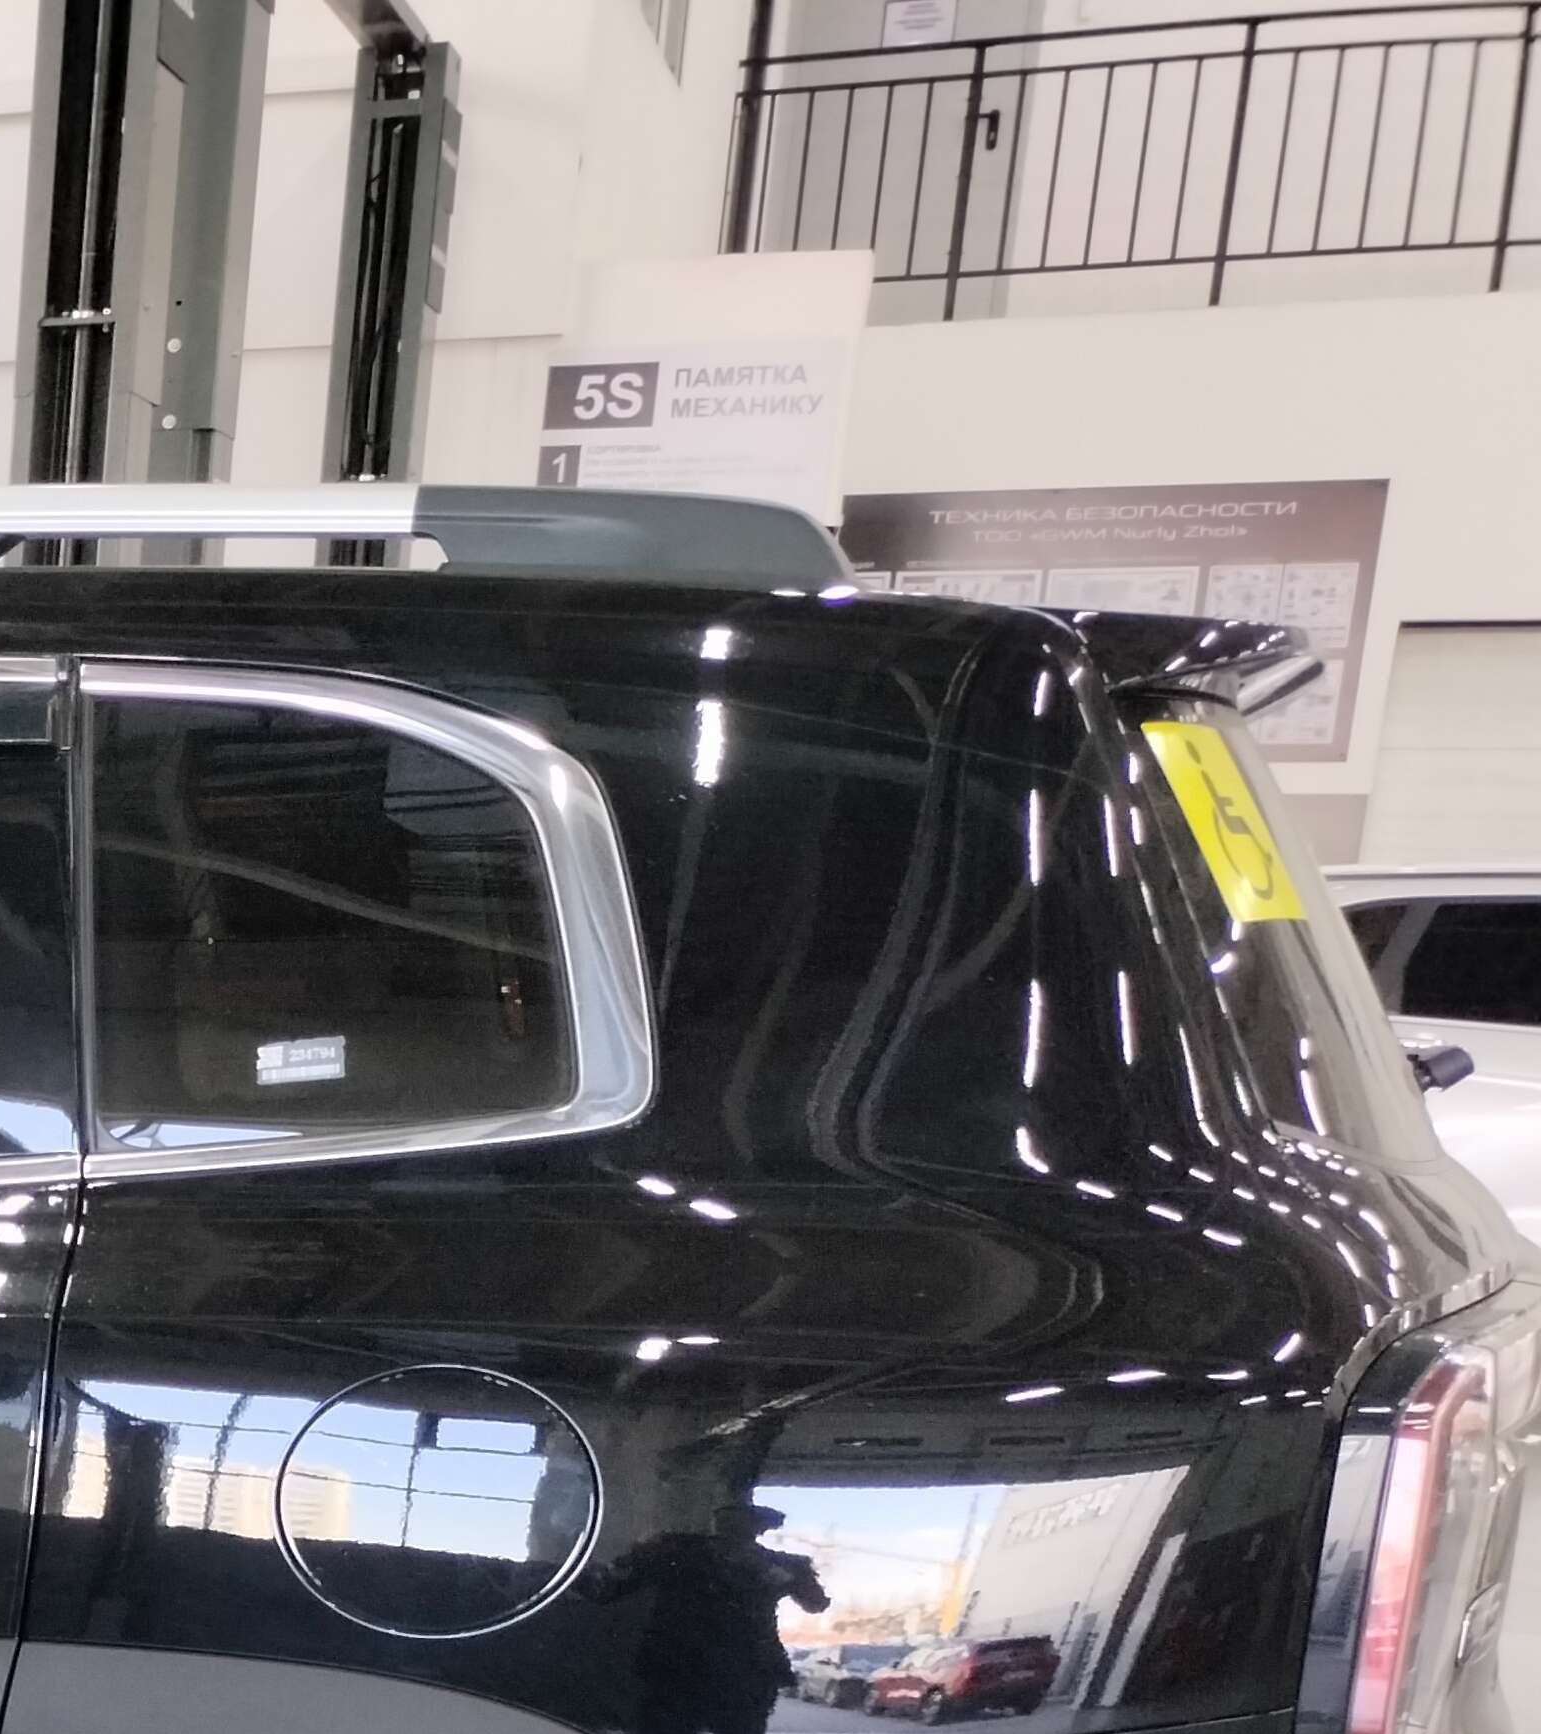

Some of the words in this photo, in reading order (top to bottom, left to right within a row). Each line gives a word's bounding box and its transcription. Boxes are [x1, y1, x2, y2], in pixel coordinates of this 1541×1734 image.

[674, 363, 809, 390] ПАМЯТКА
[573, 371, 645, 420] 5S
[670, 394, 824, 420] МЕХАНИКУ
[552, 452, 567, 484] 1
[928, 507, 1058, 525] ТЕХНИКА
[1066, 500, 1299, 522] БЕЗОПАСНОСТИ
[1114, 525, 1178, 542] Nurly
